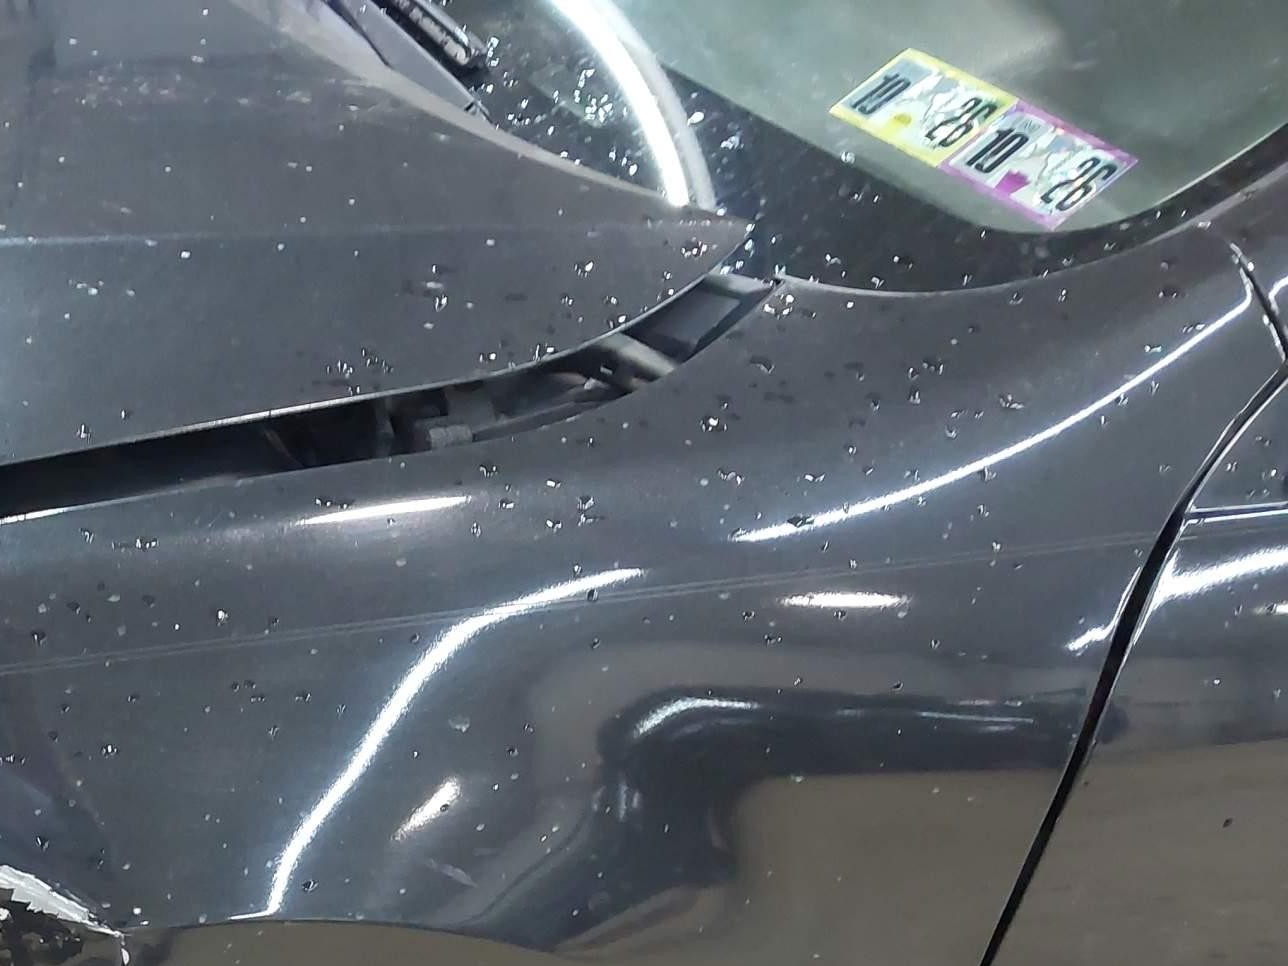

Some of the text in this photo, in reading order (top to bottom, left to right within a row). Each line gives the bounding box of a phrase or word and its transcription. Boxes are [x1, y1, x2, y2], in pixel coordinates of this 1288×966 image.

[925, 97, 998, 147] 26
[966, 127, 1118, 212] 10 26
